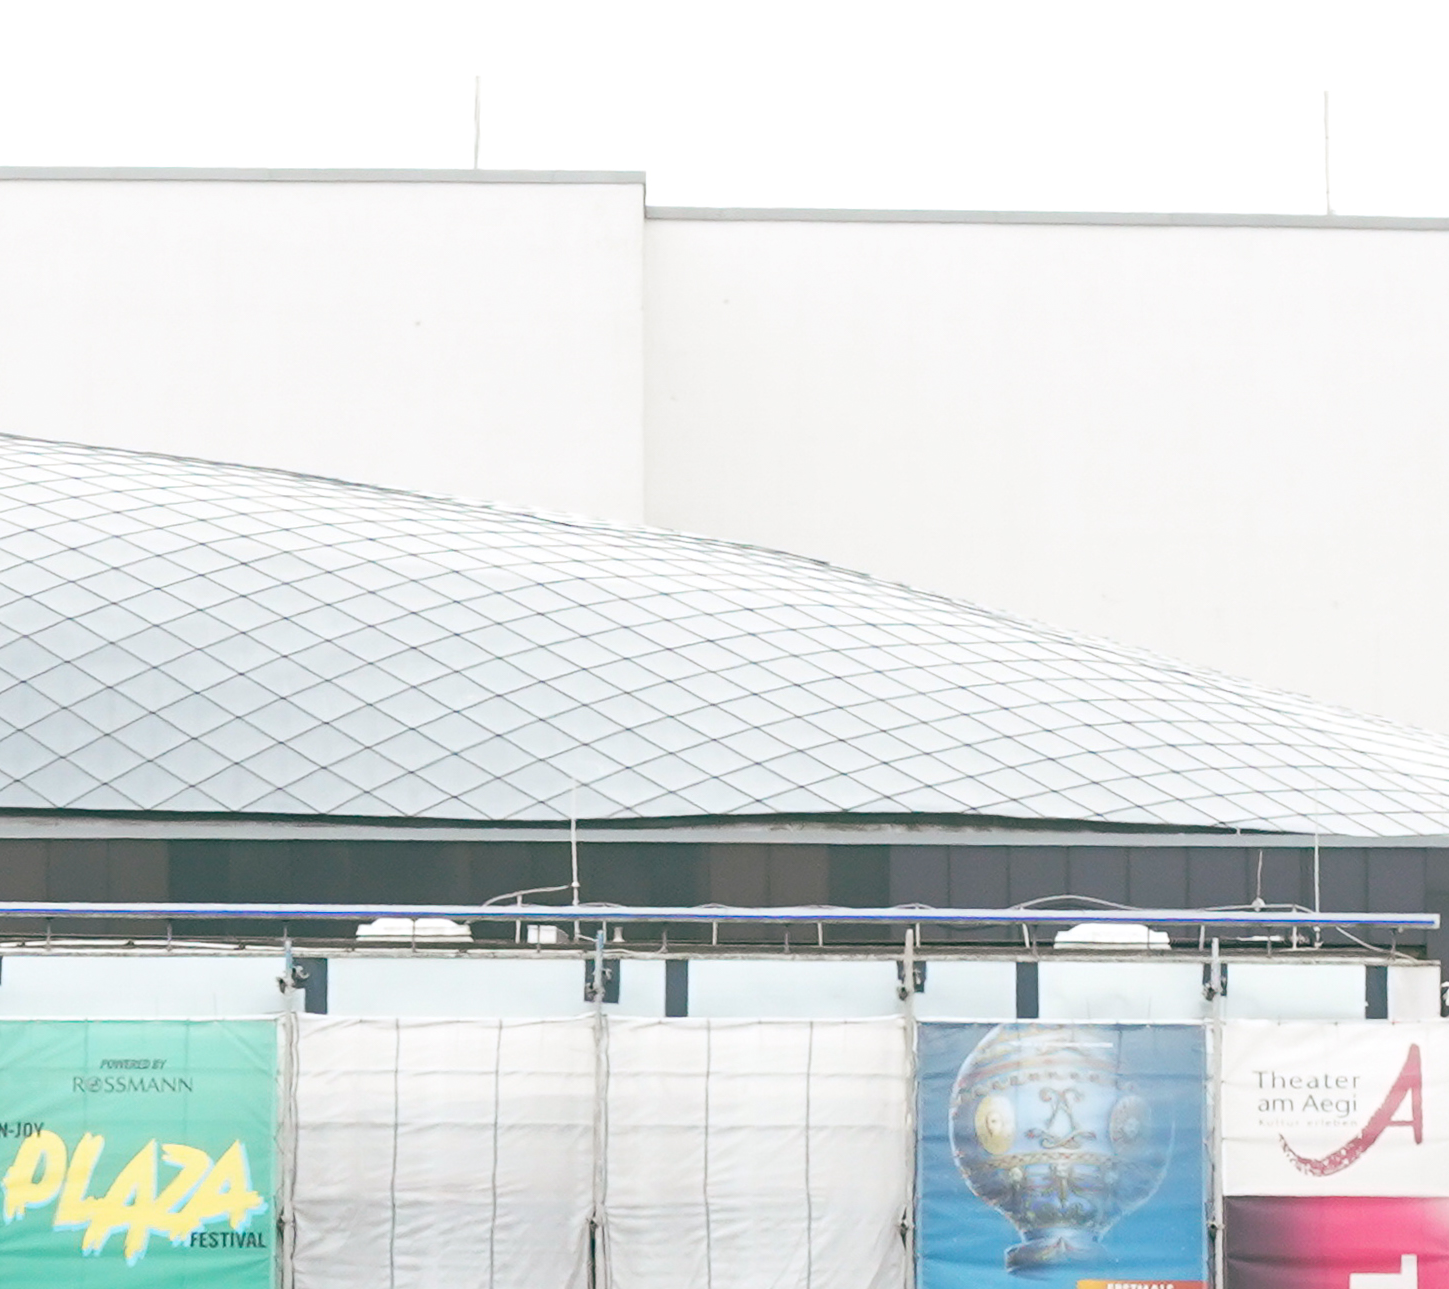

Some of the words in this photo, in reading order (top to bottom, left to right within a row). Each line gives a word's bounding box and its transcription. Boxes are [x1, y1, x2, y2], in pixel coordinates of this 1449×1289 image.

[73, 1076, 194, 1093] ROSSMANN
[1252, 1070, 1360, 1089] Theater
[1258, 1098, 1294, 1112] am
[1302, 1094, 1357, 1118] Aegi
[2, 1129, 268, 1267] PLAZA
[190, 1232, 267, 1249] FESTIVAL
